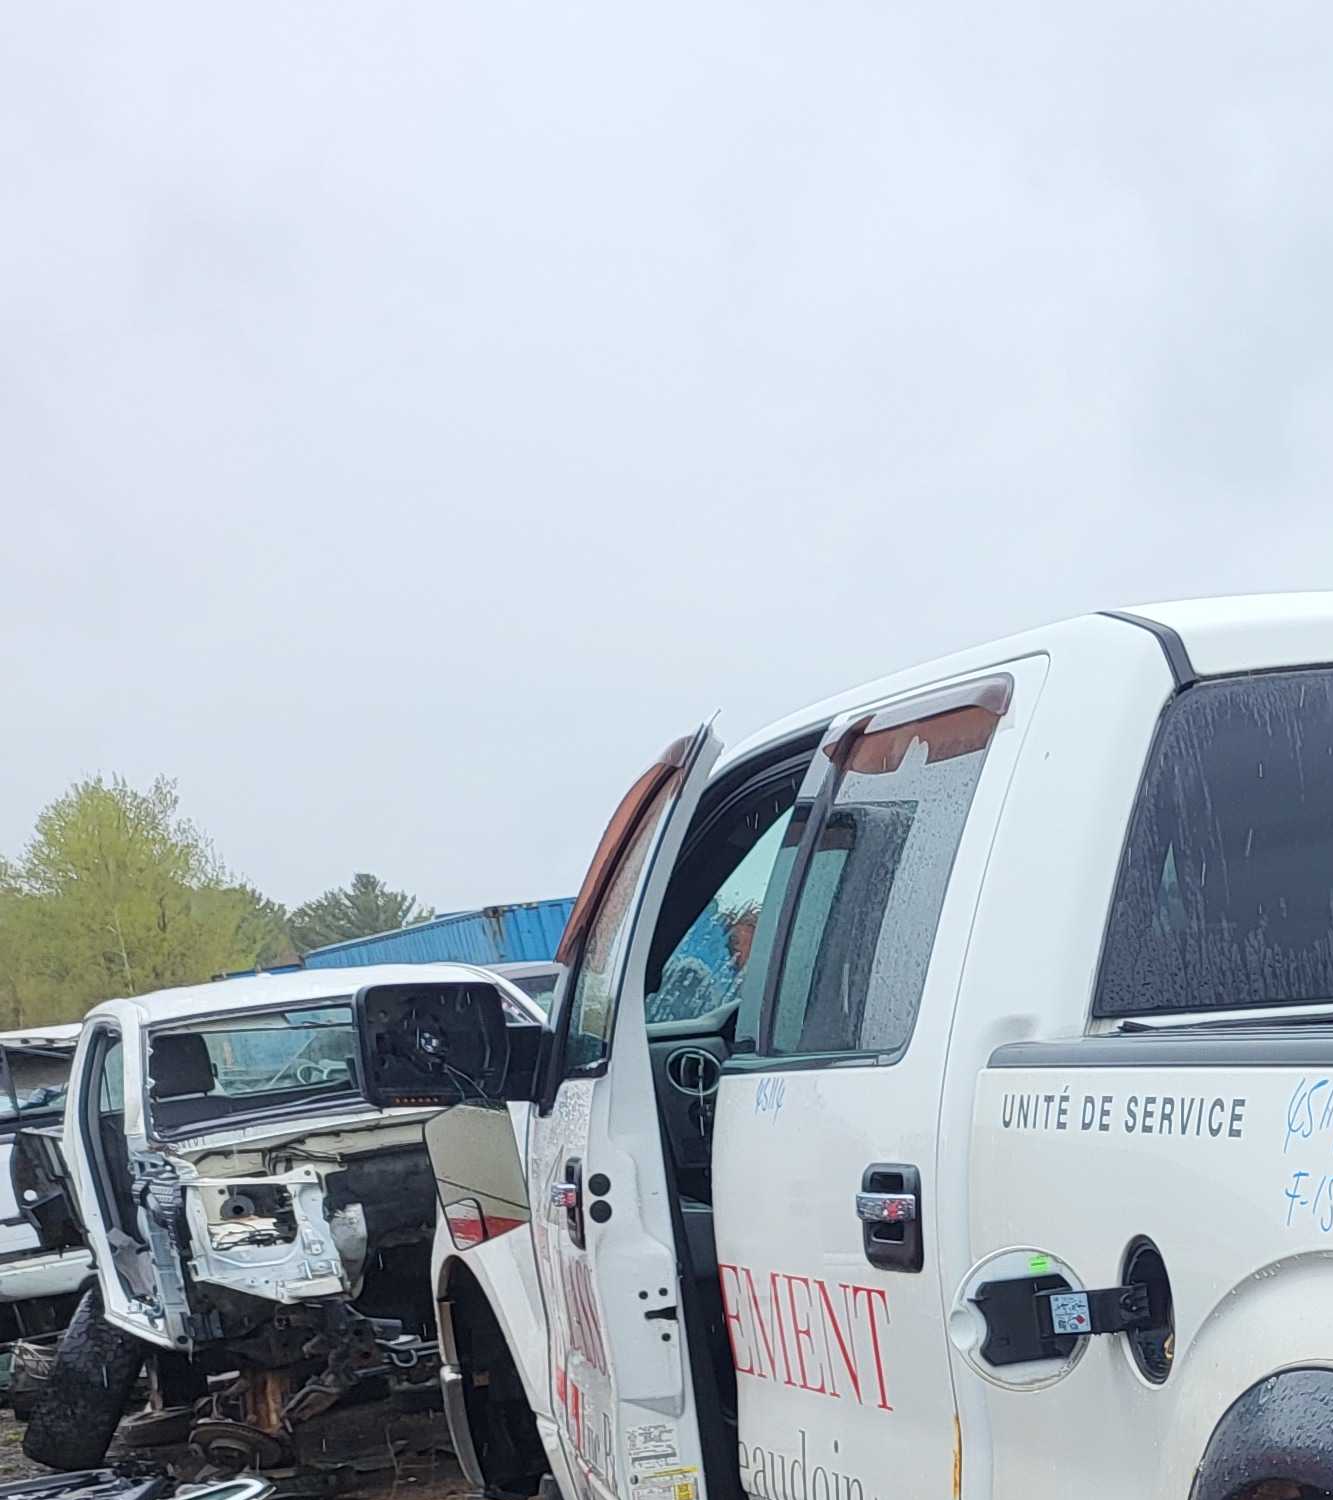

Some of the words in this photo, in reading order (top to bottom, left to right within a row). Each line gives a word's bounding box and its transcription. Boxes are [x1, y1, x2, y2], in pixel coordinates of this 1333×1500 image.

[1001, 1085, 1070, 1130] UNITÉ
[1081, 1095, 1113, 1132] DE
[1124, 1095, 1246, 1138] SERVICE
[718, 1263, 894, 1412] EMENT
